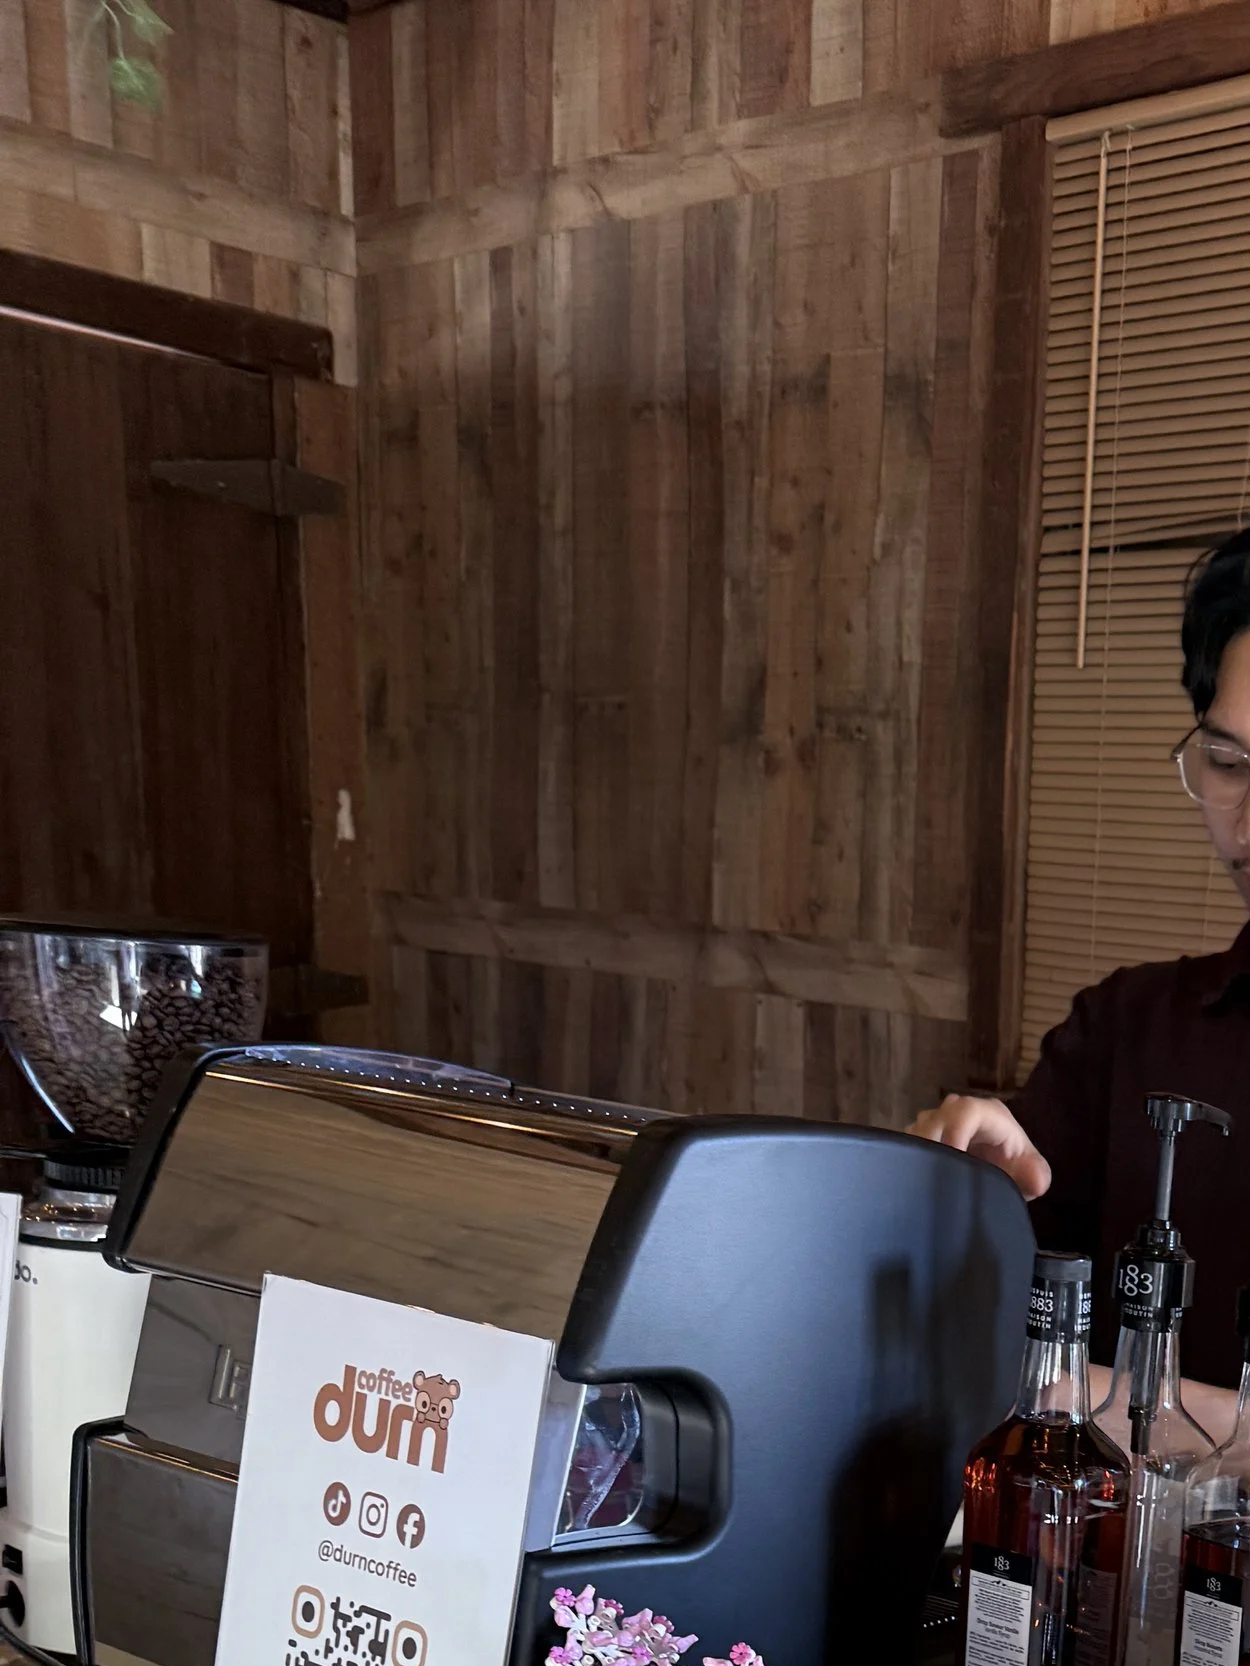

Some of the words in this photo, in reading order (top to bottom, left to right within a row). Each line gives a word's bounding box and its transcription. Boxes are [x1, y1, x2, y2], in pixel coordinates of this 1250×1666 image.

[1030, 1296, 1054, 1312] 883
[357, 1368, 413, 1402] coffee
[313, 1364, 448, 1474] durn
[318, 1540, 417, 1588] @durncoffee
